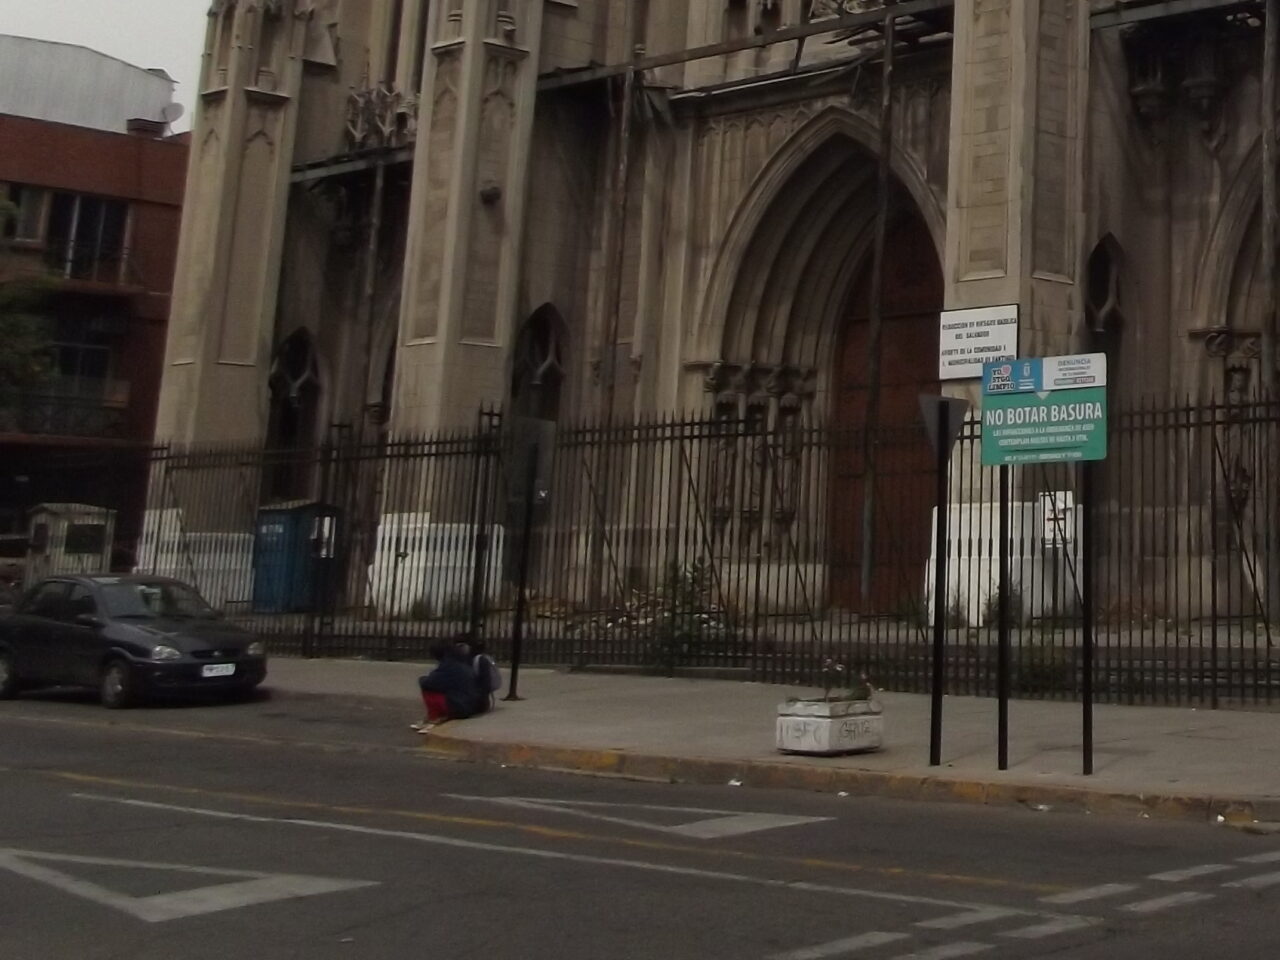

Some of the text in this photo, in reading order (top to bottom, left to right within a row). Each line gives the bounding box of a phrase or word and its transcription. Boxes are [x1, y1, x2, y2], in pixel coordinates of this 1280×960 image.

[986, 402, 1102, 426] NO BOTAR BASURA
